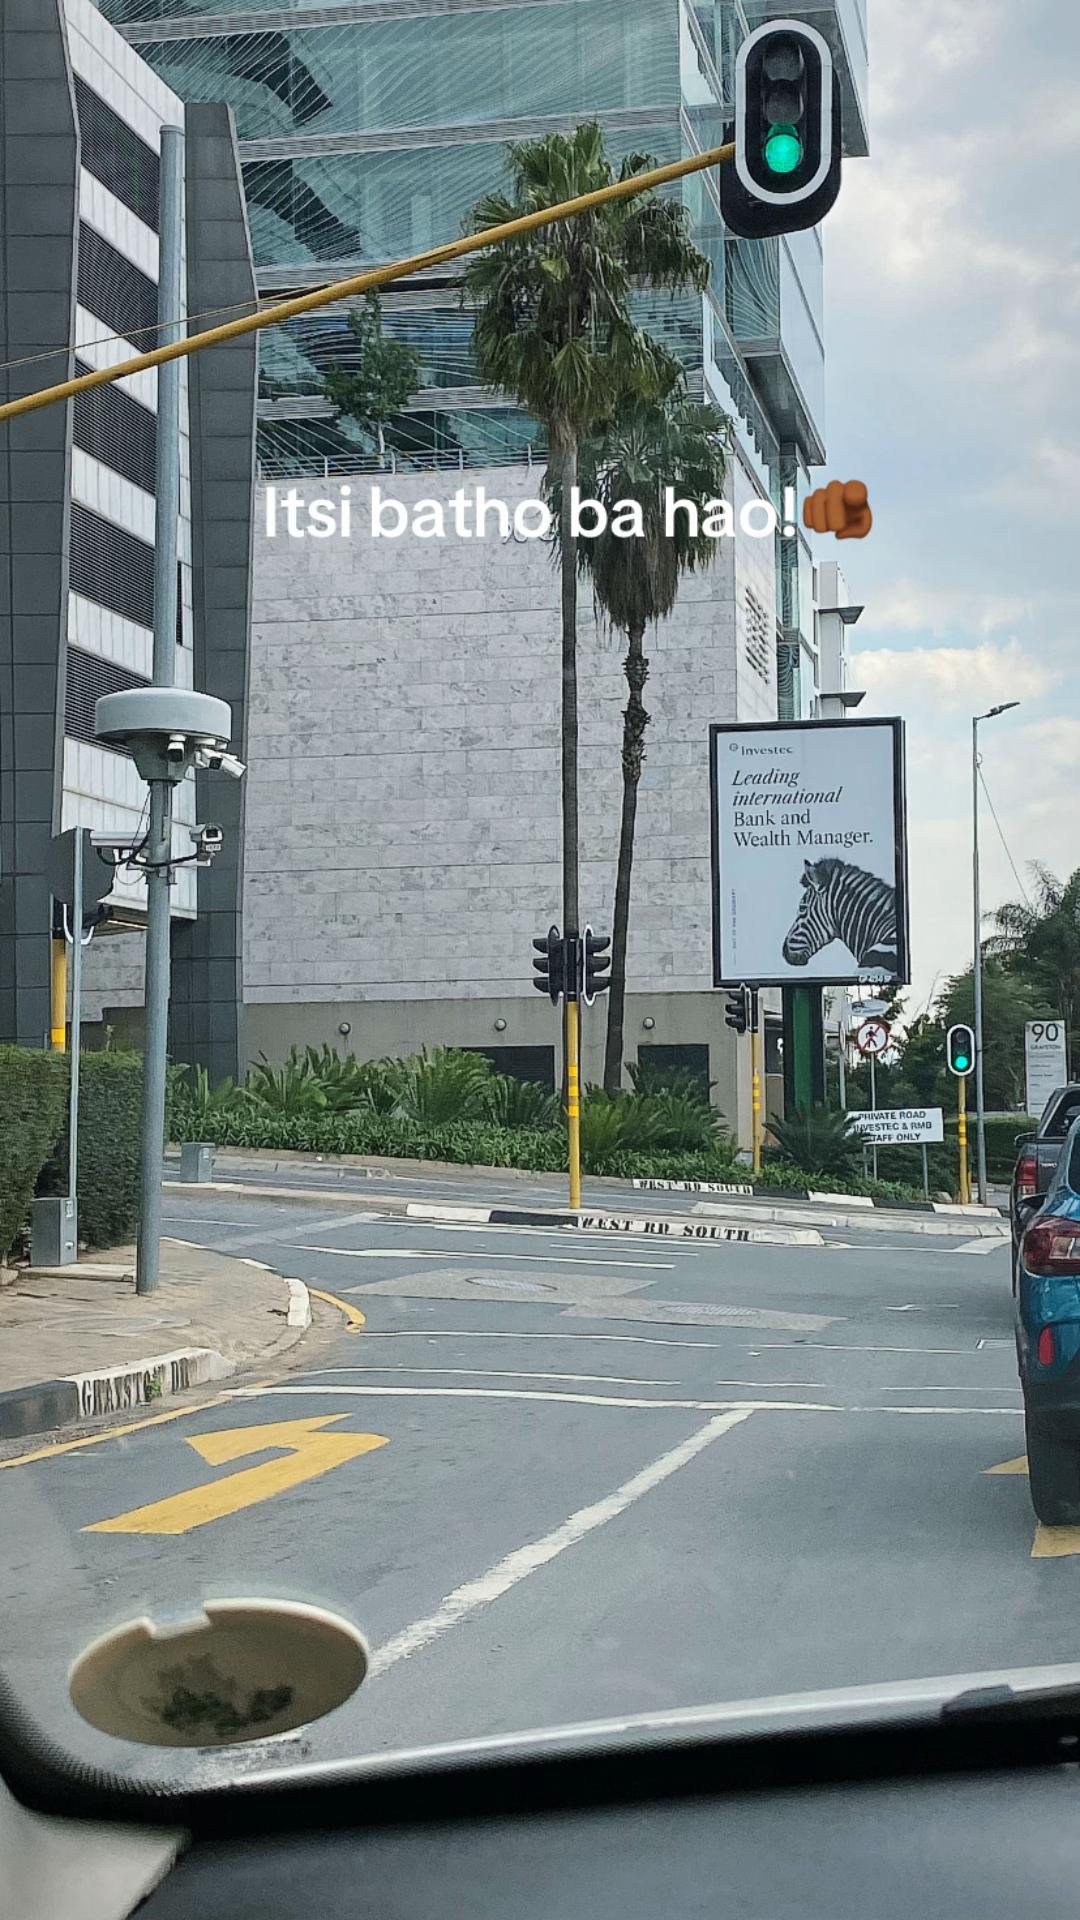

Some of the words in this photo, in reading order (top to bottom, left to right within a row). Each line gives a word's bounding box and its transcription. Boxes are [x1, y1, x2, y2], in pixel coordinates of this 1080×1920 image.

[741, 745, 793, 756] Investec
[731, 767, 801, 788] Leading
[732, 786, 843, 807] international
[734, 809, 776, 828] Bank
[780, 808, 811, 826] and
[733, 829, 791, 848] Wealth
[797, 829, 874, 849] Manager.
[1032, 1022, 1059, 1043] 90
[858, 1111, 897, 1120] PRIVATE
[899, 1110, 927, 1120] ROAD
[854, 1122, 900, 1132] INVESTEC
[902, 1122, 909, 1131] &
[911, 1121, 932, 1130] RMB
[866, 1133, 893, 1142] TAFF
[896, 1132, 921, 1142] ONLY
[639, 1179, 674, 1190] WEST
[684, 1182, 701, 1193] RD
[707, 1183, 752, 1195] SOUTH
[580, 1216, 633, 1232] WEST
[643, 1221, 670, 1236] RD
[683, 1225, 750, 1241] SOUTH
